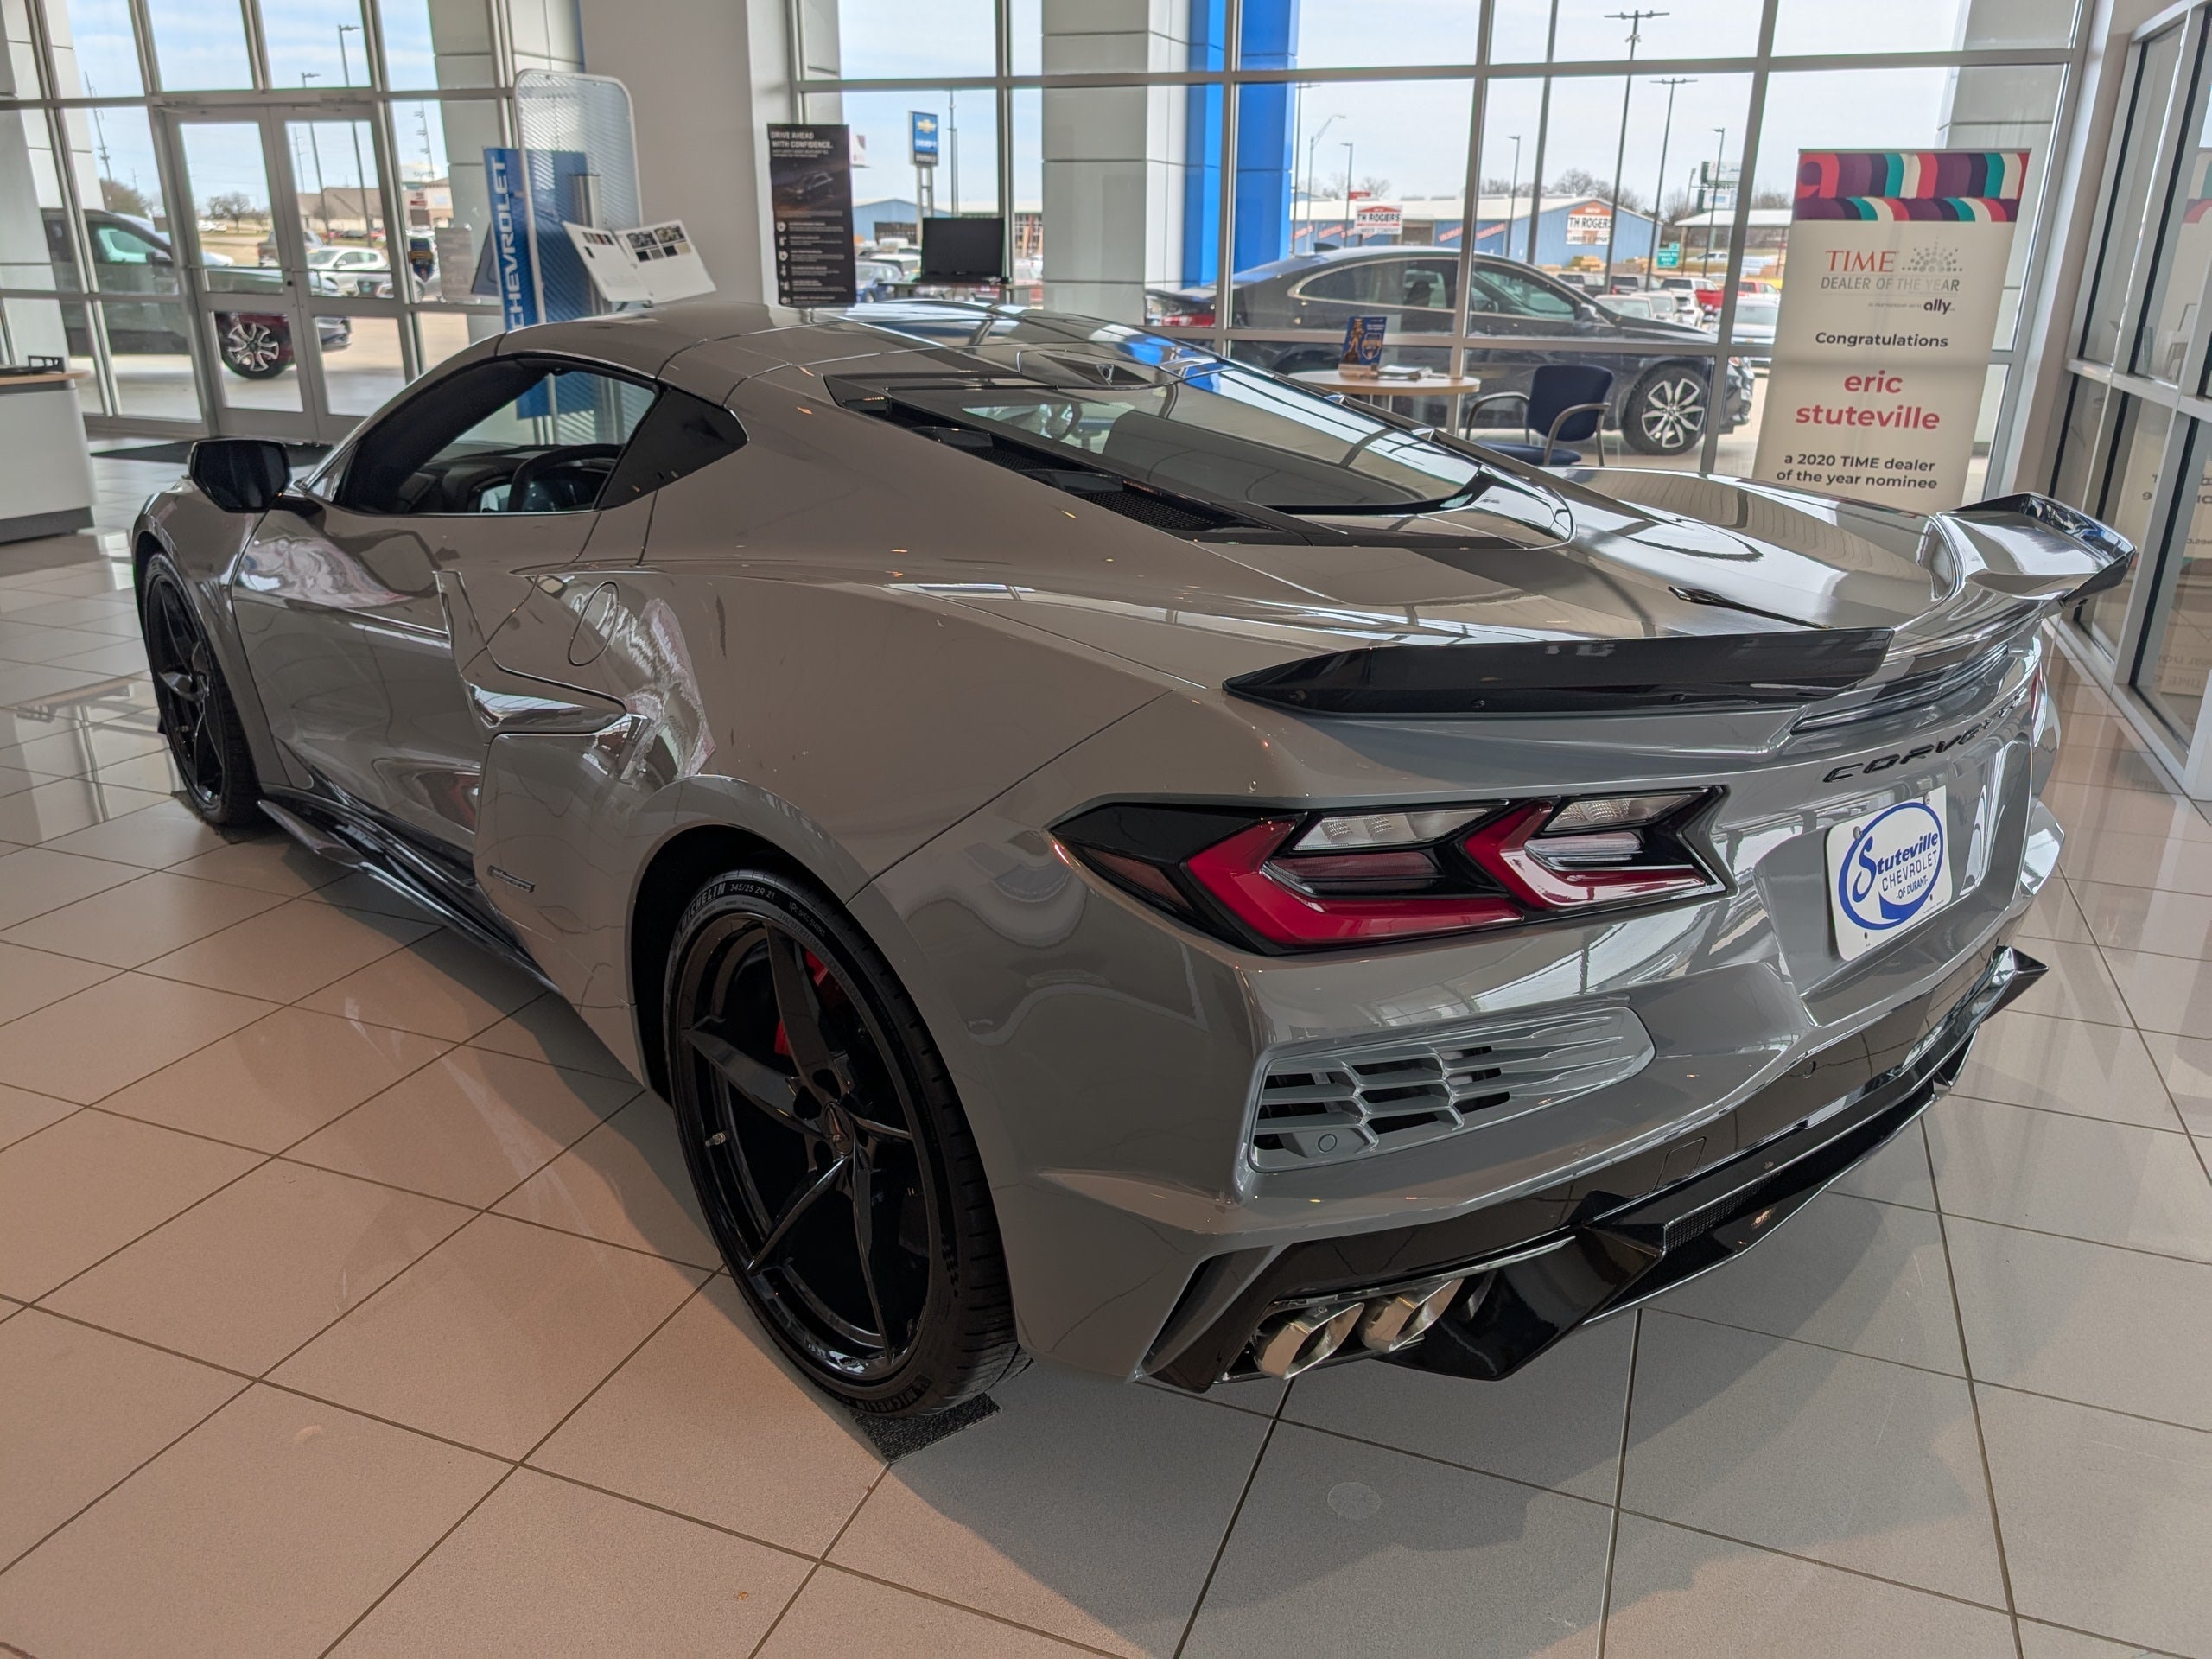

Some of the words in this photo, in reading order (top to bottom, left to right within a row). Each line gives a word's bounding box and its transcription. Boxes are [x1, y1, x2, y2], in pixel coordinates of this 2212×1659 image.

[1369, 213, 1400, 222] ROGERS
[1569, 217, 1580, 228] TH
[491, 156, 525, 331] CHEVROLET
[1825, 250, 1897, 273] TIME
[1821, 276, 1871, 290] DEALER
[1876, 277, 1893, 290] OF
[1897, 278, 1922, 291] THE
[1926, 279, 1960, 292] YEAR
[1923, 298, 1952, 315] ally
[1815, 332, 1948, 347] Congratulations
[1844, 370, 1904, 394] eric
[1795, 404, 1941, 430] stuteville
[1783, 454, 1793, 465] a
[1797, 454, 1836, 467] 2020
[1840, 455, 1880, 469] TIME
[1884, 458, 1936, 472] dealer
[1777, 469, 1793, 480] of
[1796, 470, 1822, 483] the
[1826, 474, 1861, 486] year
[1865, 474, 1938, 489] nominee
[1852, 832, 1938, 903] Stuteville
[1882, 849, 1937, 892] CHEVROLET
[682, 882, 726, 931] MICHELIN
[730, 883, 753, 893] 345/25
[766, 890, 776, 899] 21
